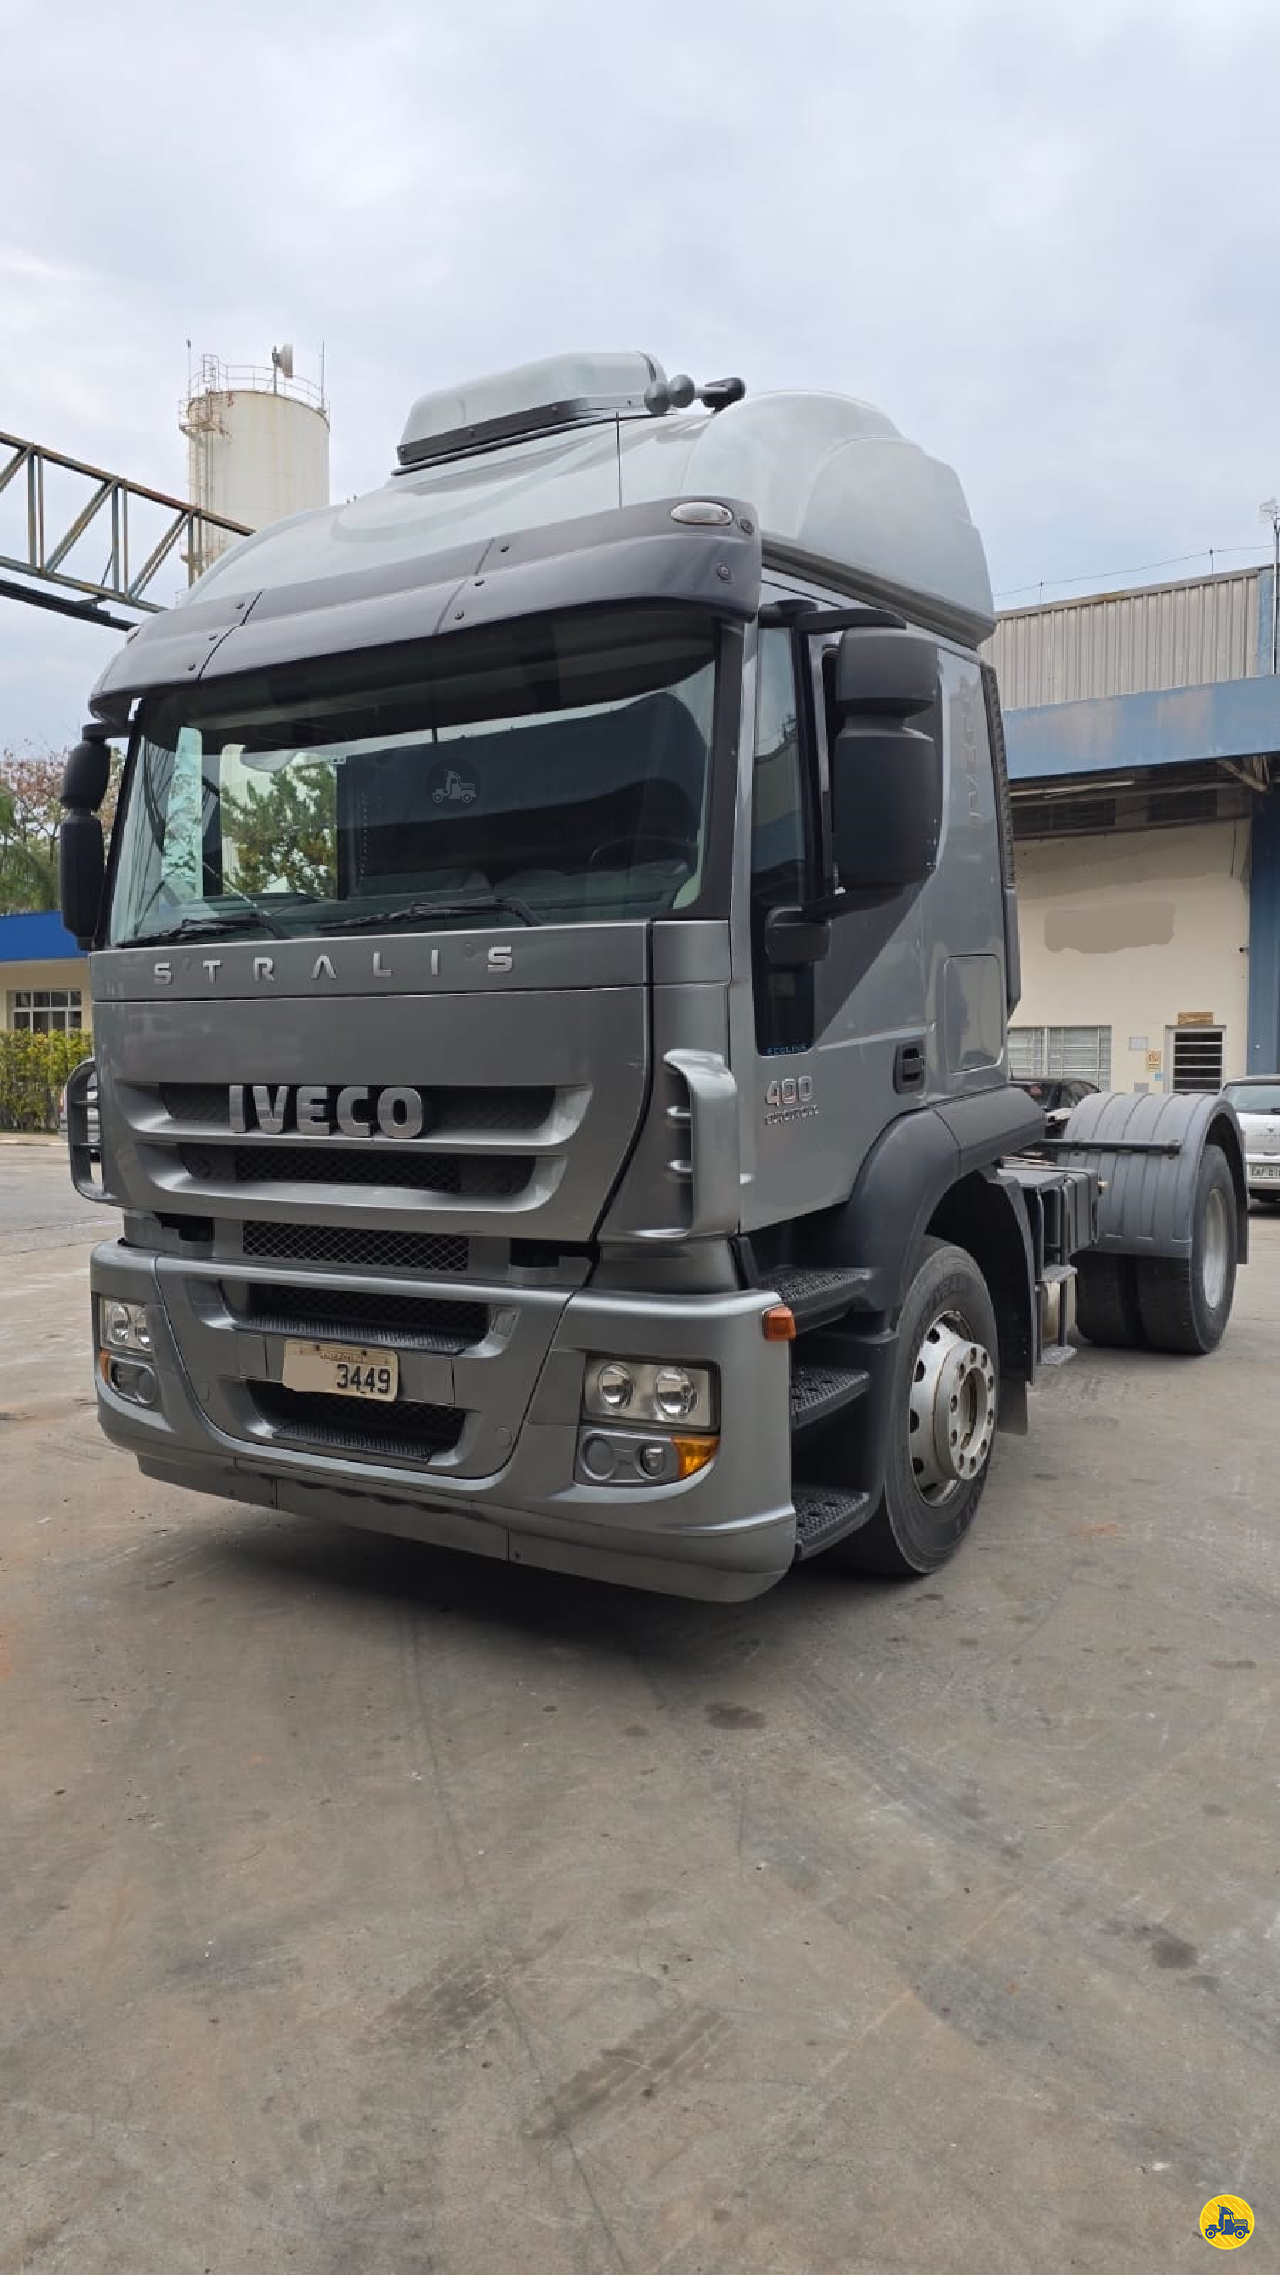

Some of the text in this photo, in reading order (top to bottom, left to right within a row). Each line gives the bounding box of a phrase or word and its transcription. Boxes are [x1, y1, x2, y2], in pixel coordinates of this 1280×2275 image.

[154, 945, 513, 985] STRALIS
[767, 1076, 812, 1106] 400
[229, 1085, 423, 1138] IVECO
[337, 1363, 391, 1394] 3449
